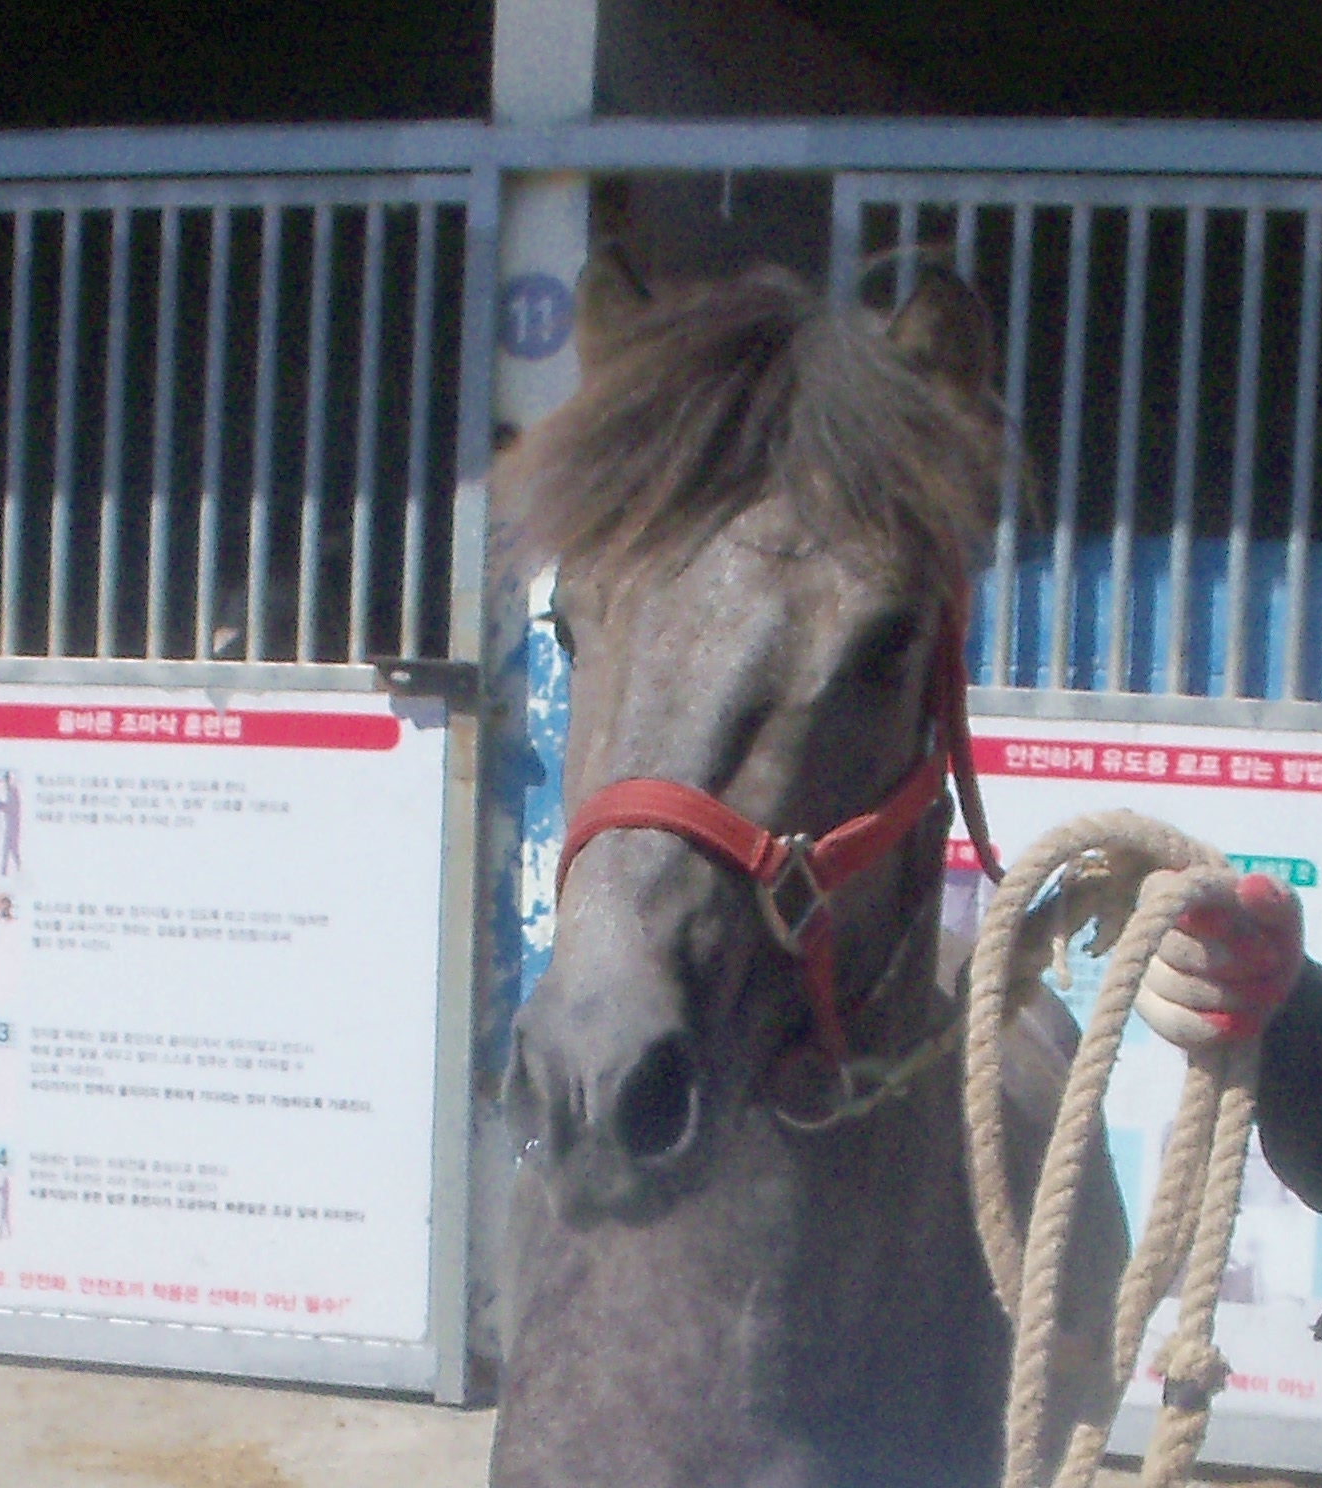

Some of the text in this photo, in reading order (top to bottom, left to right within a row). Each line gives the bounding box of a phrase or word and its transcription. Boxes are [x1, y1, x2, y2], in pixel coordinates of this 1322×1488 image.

[56, 707, 114, 736] 올바른
[119, 711, 178, 737] 조마삭
[1004, 742, 1095, 774] 안전하게
[1101, 748, 1168, 777] 유도용
[1175, 752, 1222, 778] 로프
